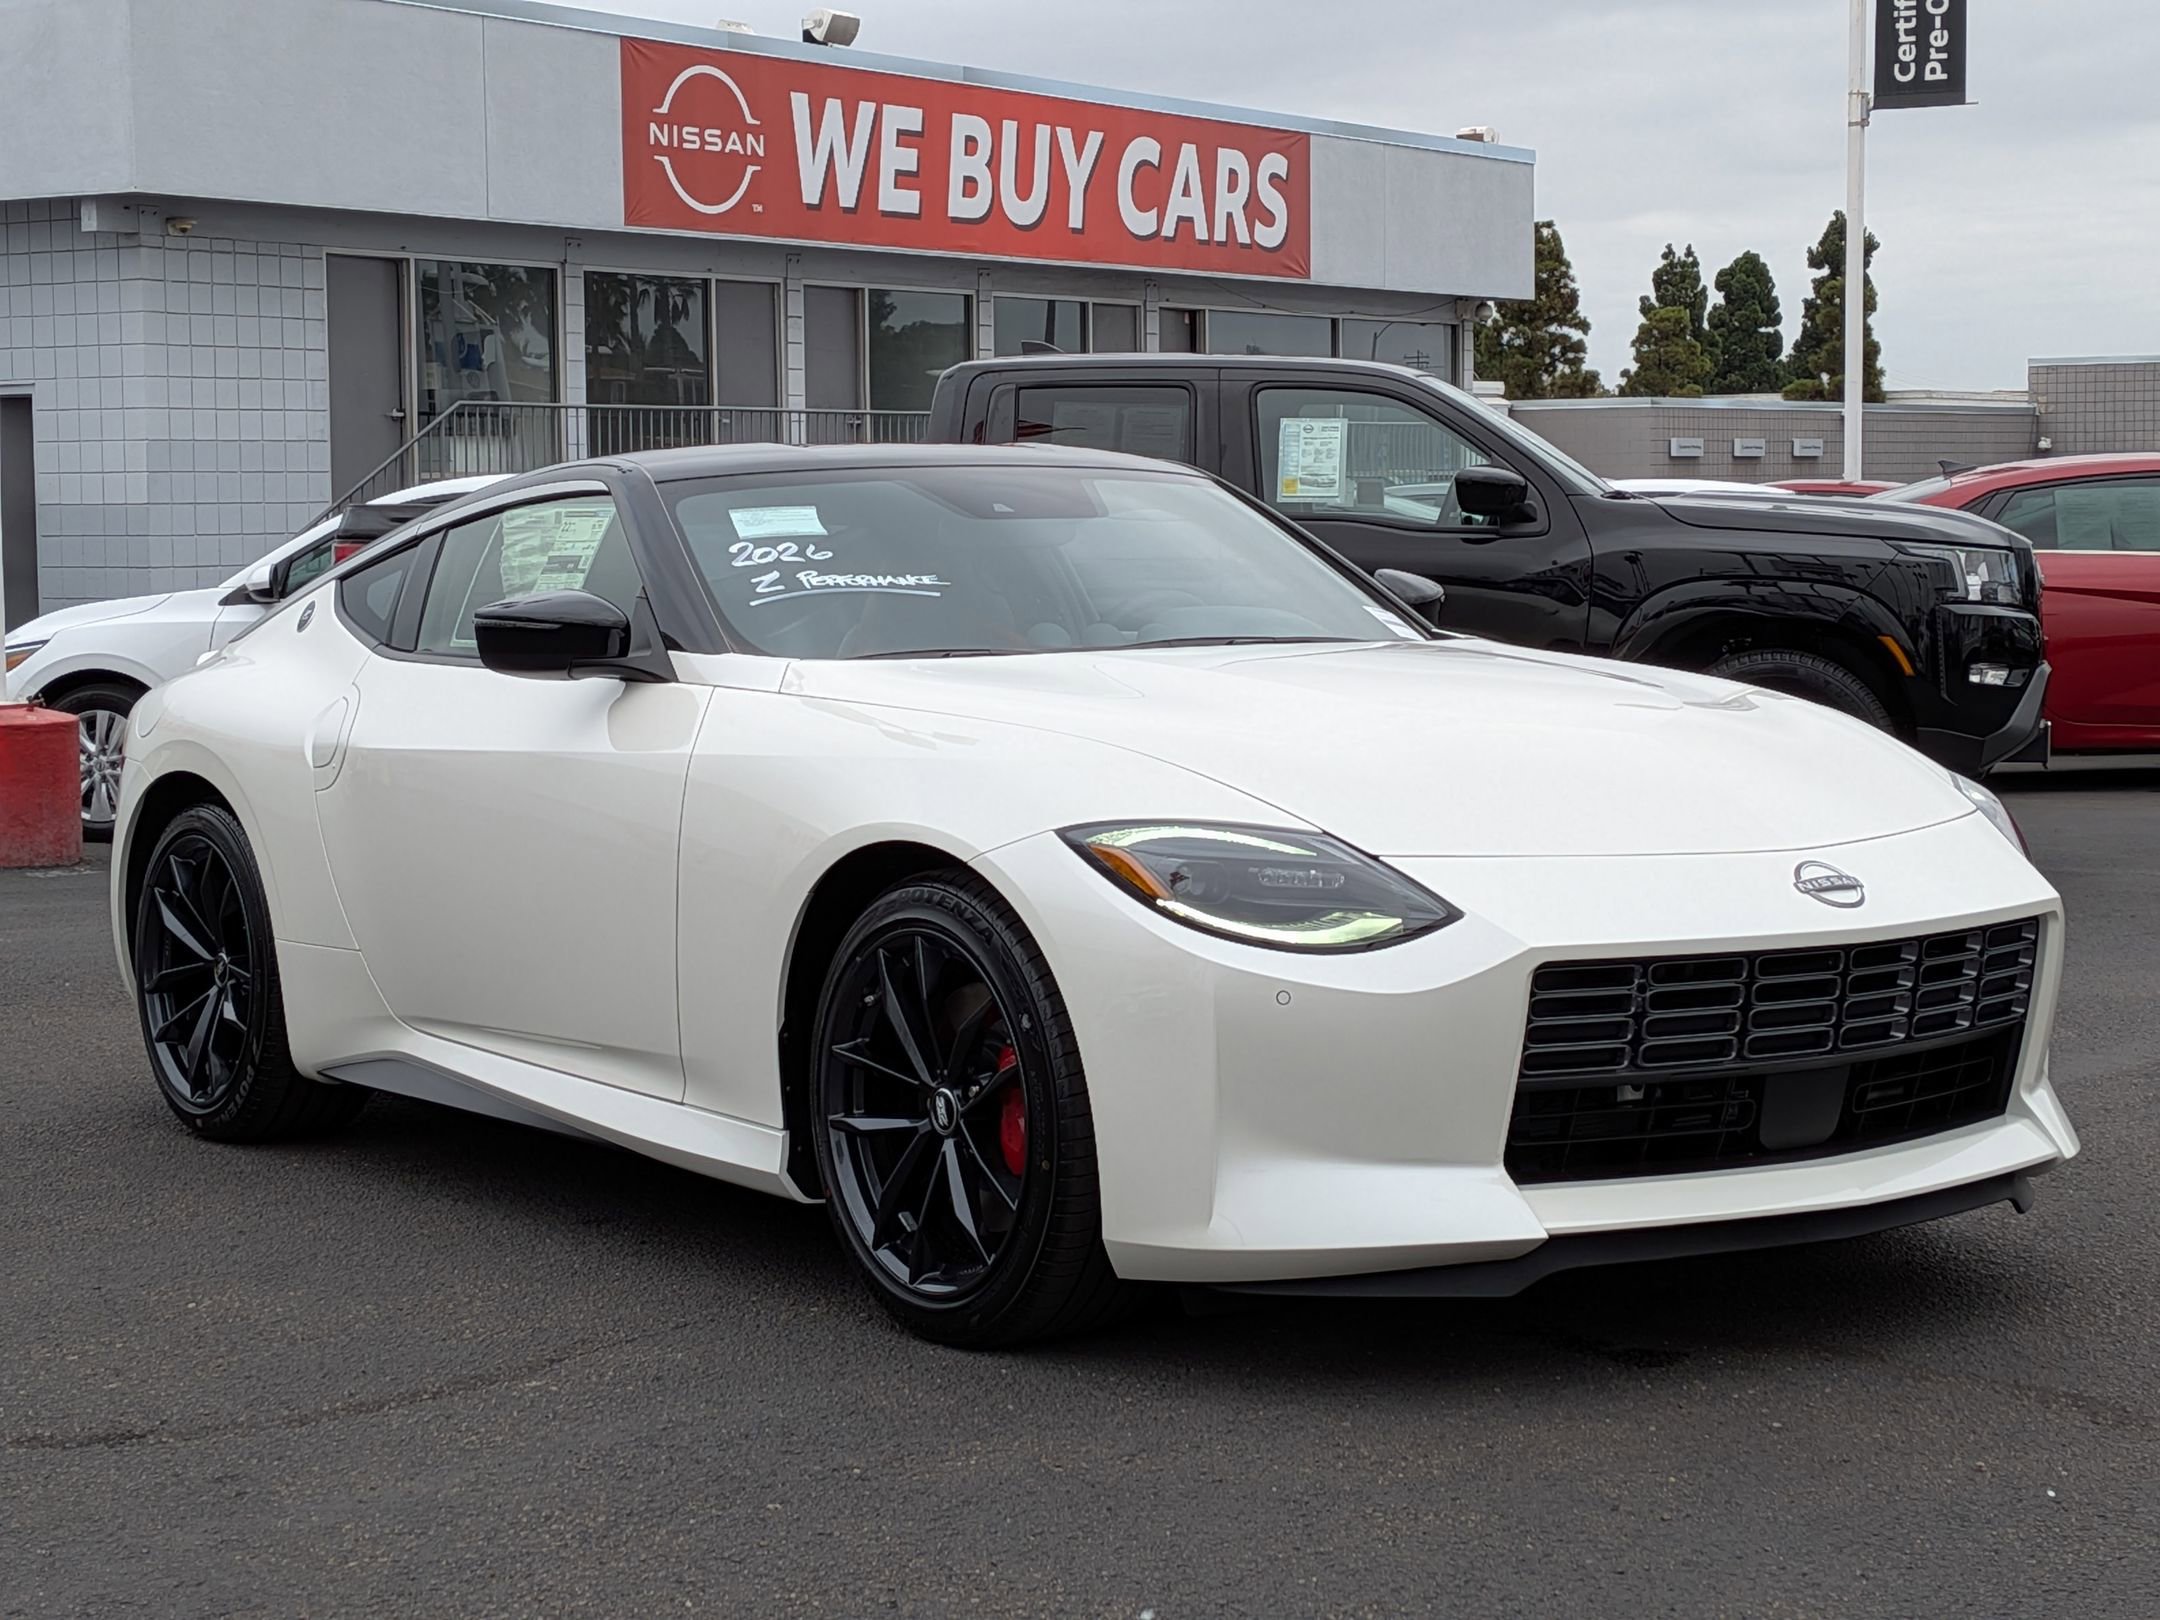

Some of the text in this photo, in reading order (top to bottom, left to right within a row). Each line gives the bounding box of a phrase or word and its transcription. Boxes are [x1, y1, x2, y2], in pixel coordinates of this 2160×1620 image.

[649, 122, 765, 157] NISSAN
[790, 91, 1289, 248] WE BUY CARS
[728, 541, 834, 567] 2026
[750, 570, 786, 593] Z
[898, 888, 996, 946] POTENZA
